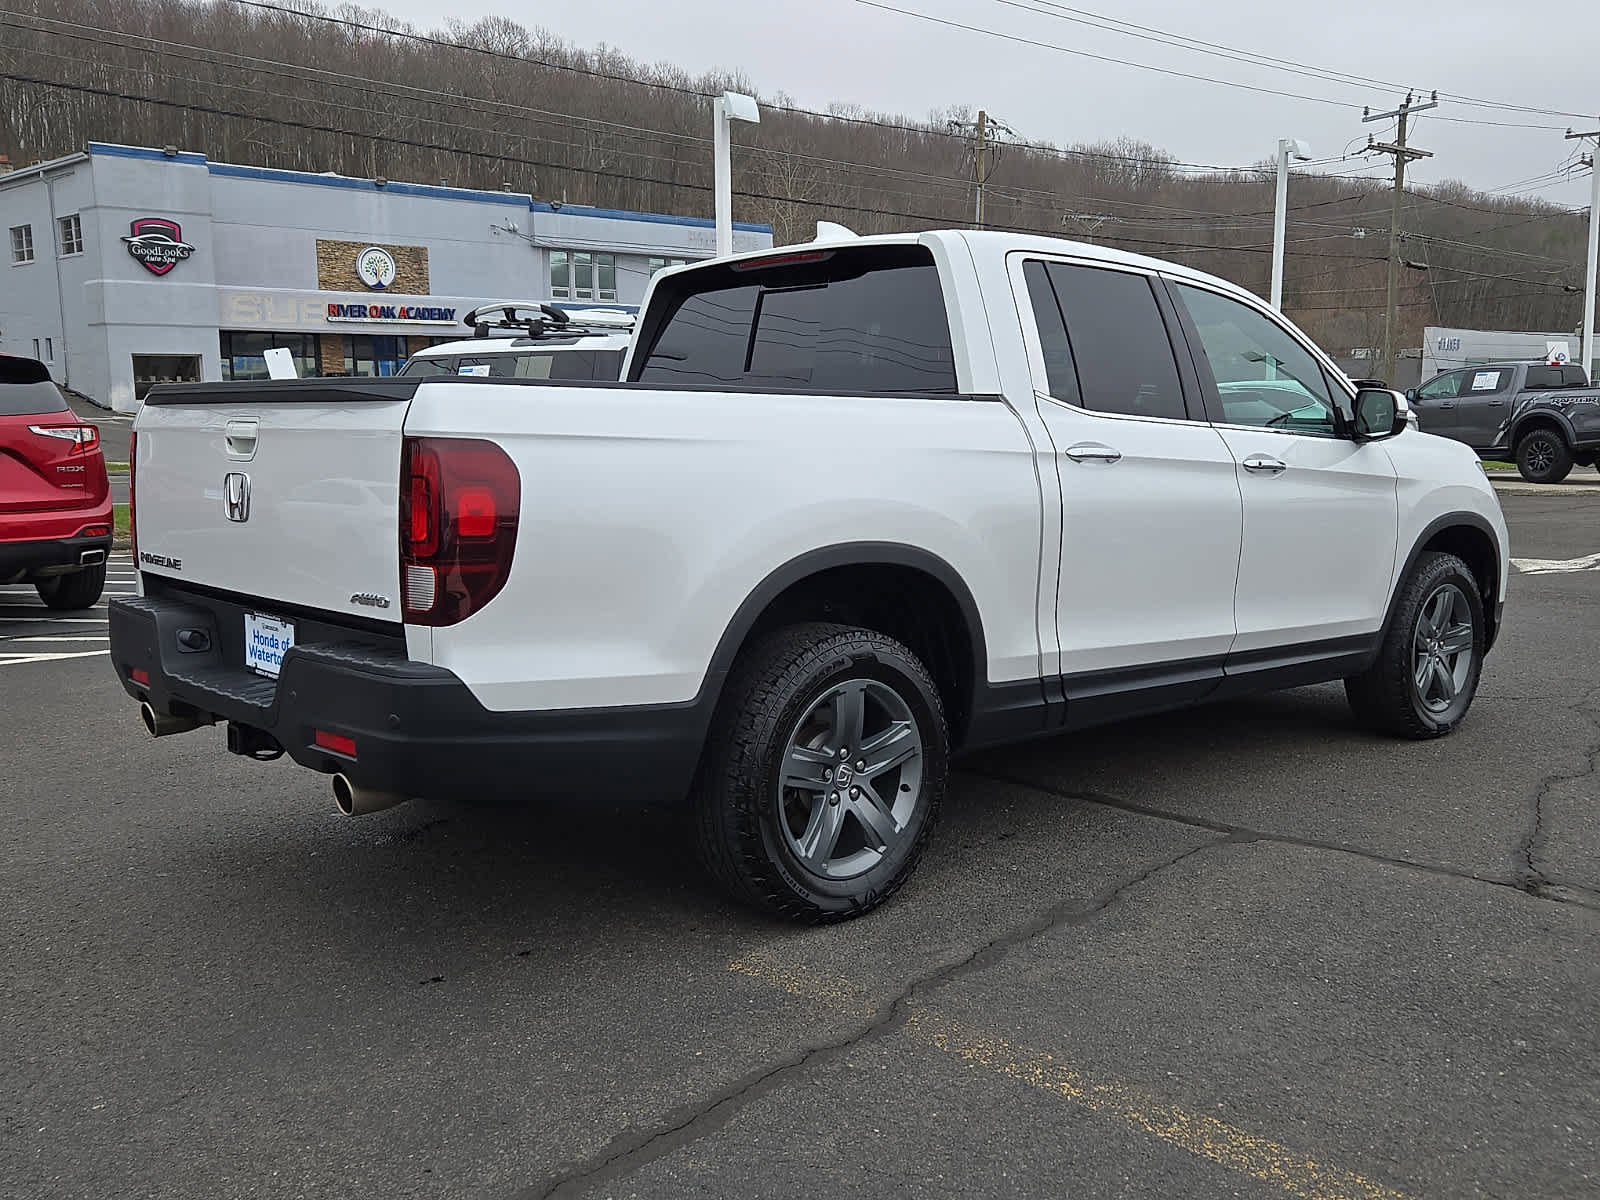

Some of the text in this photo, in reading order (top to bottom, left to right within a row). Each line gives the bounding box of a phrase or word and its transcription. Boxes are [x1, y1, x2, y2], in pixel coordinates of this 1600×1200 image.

[144, 254, 176, 264] Auto Spa
[328, 303, 368, 318] RIVER
[369, 305, 396, 319] OAK
[398, 306, 456, 321] ACADEMY
[56, 465, 85, 473] RDX
[252, 628, 280, 650] Honda
[281, 637, 290, 652] of
